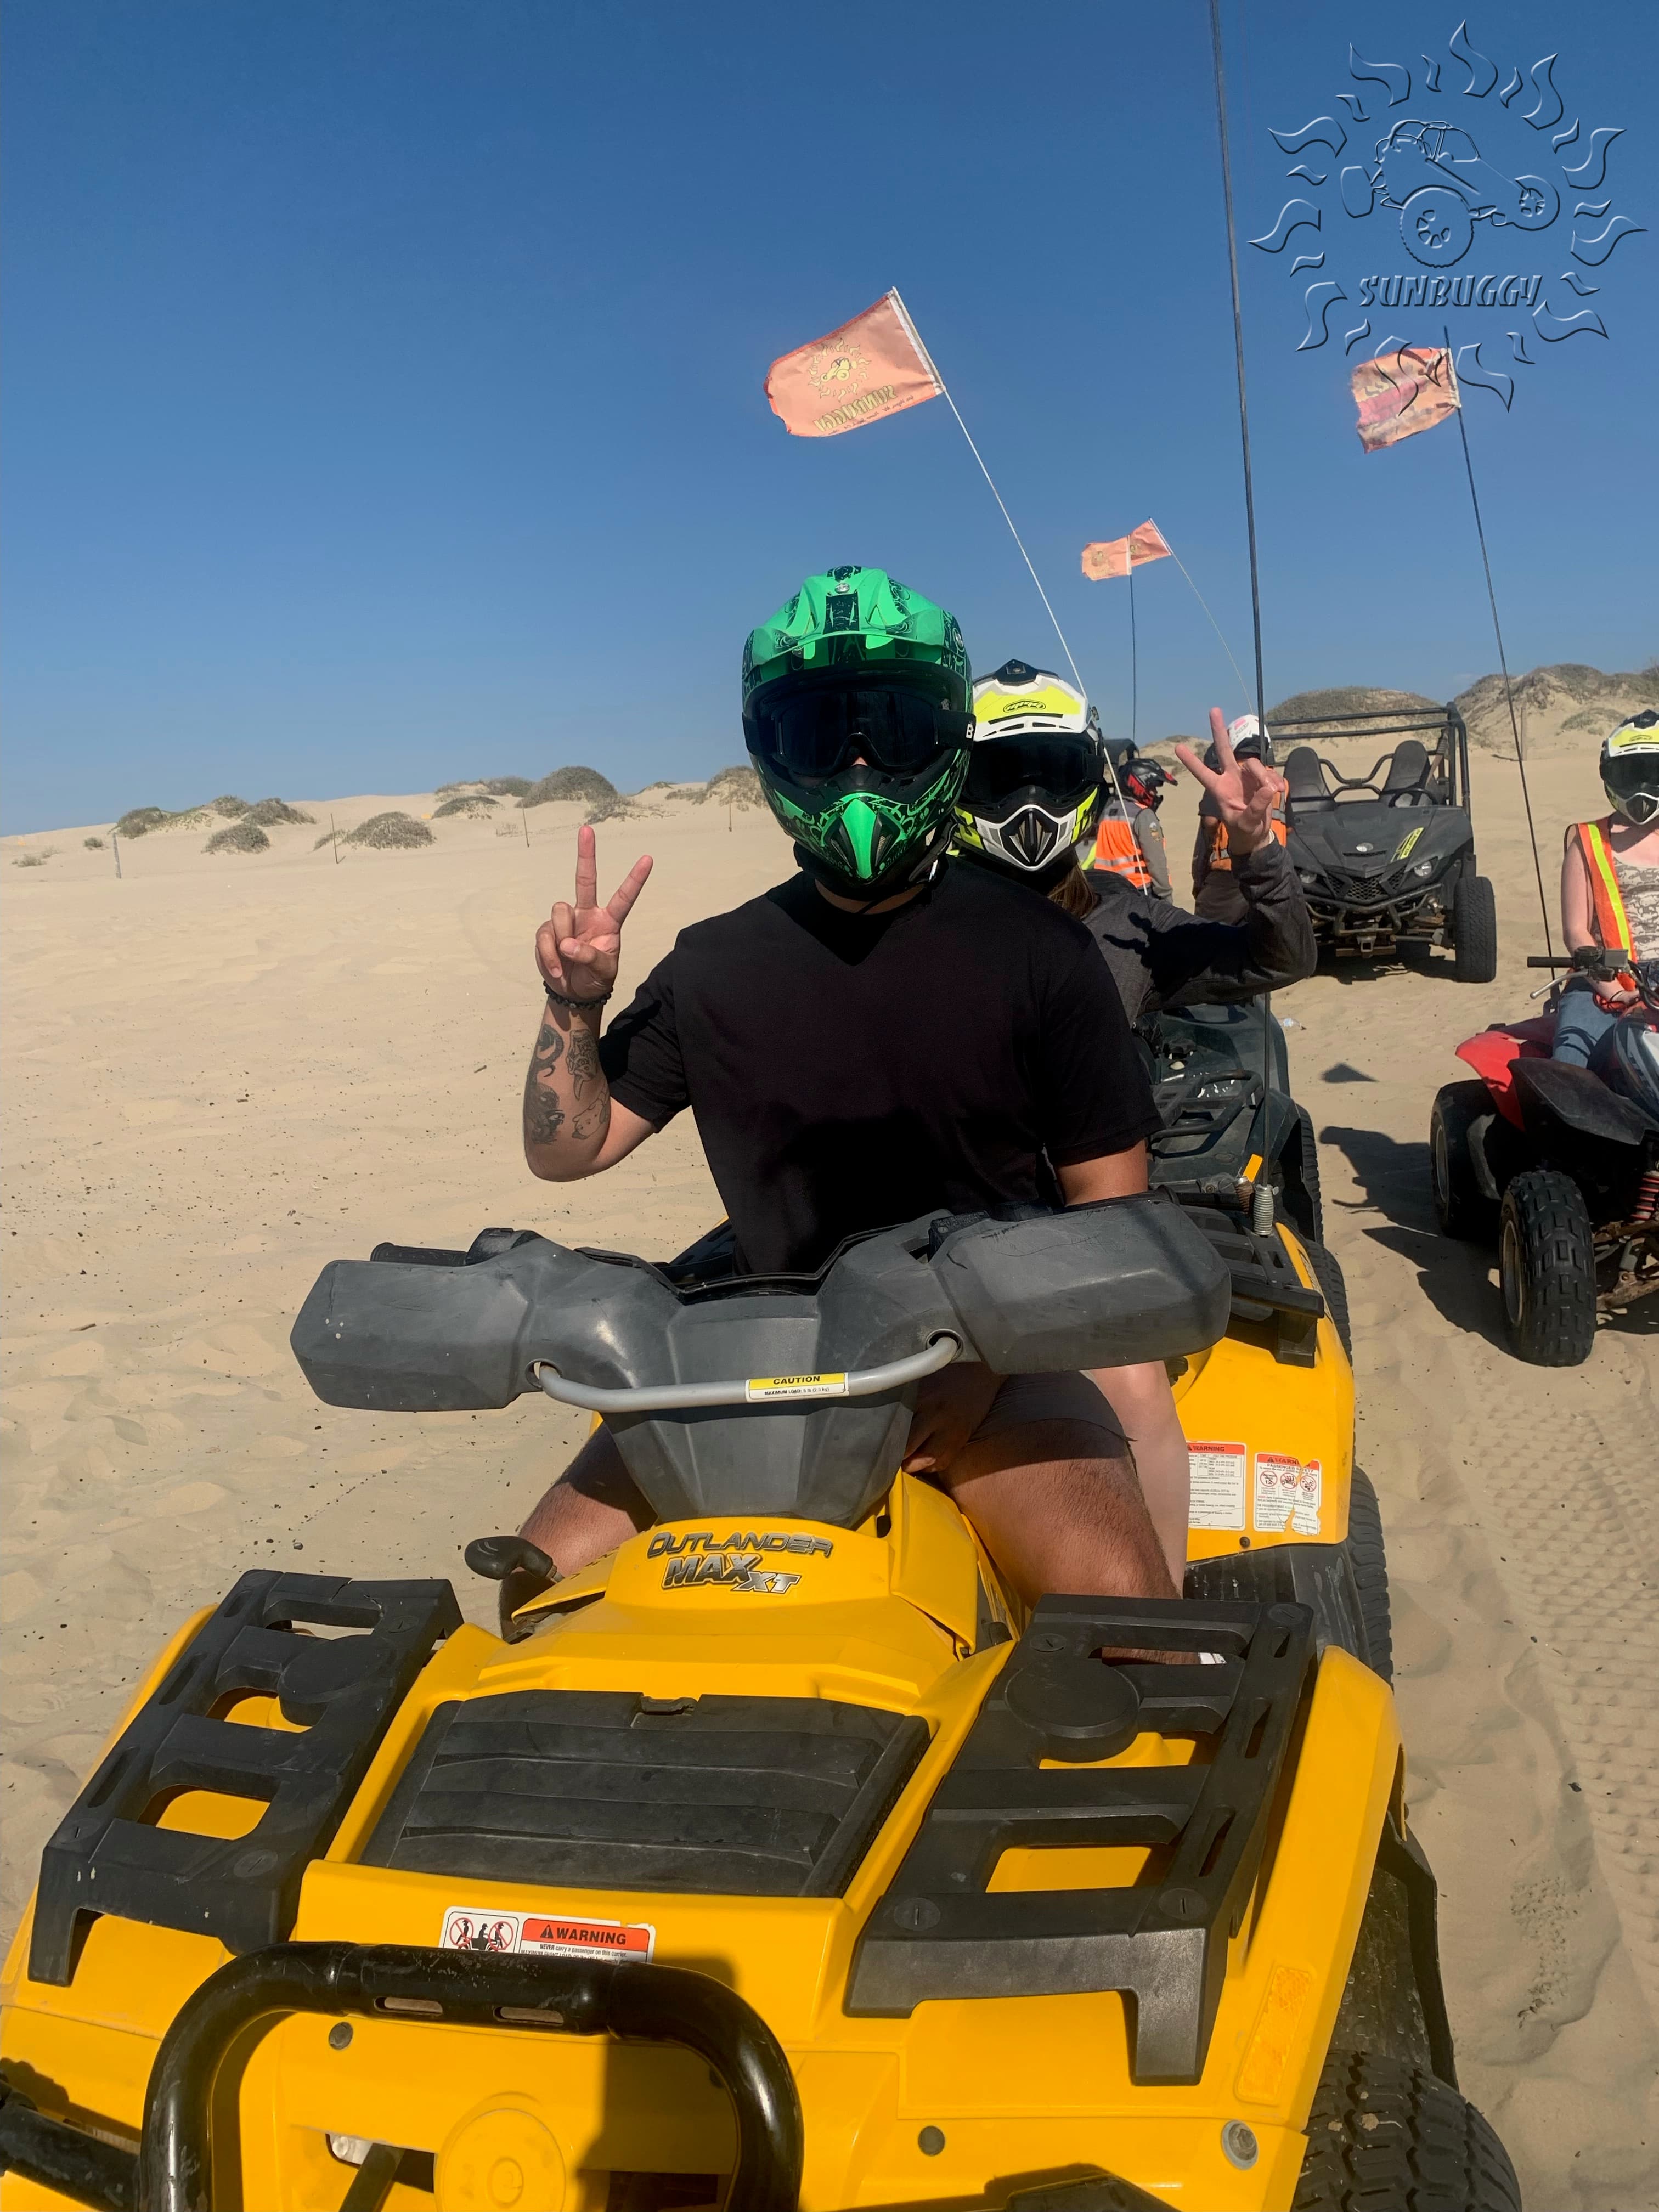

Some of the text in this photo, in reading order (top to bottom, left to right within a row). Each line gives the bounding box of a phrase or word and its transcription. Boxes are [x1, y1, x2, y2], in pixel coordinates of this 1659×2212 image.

[773, 1376, 820, 1385] CAUTION
[647, 1531, 834, 1558] OUTLANDER
[662, 1553, 802, 1594] MAX XT
[556, 1927, 627, 1945] WARNING
